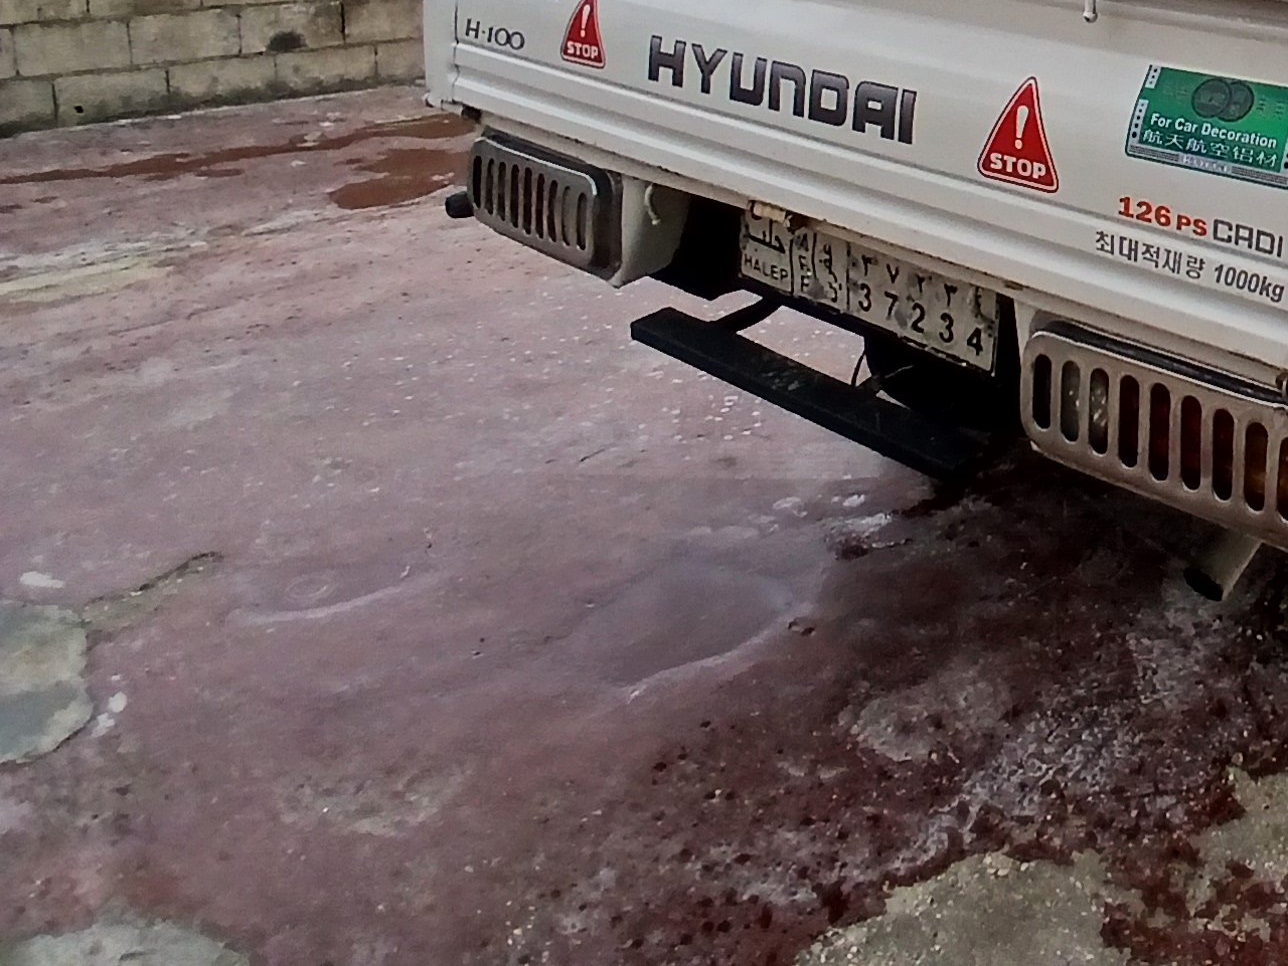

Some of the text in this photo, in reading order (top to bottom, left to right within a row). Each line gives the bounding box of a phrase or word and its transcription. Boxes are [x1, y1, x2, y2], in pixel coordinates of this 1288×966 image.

[567, 41, 599, 60] STOP
[648, 34, 918, 145] HYUNDAI
[1142, 129, 1278, 168] 航天航空铝材
[1150, 112, 1278, 149] For Car Decoration
[989, 152, 1047, 180] STOP
[744, 253, 788, 281] HALEP
[1095, 230, 1285, 303] 최대적재량 1000kg
